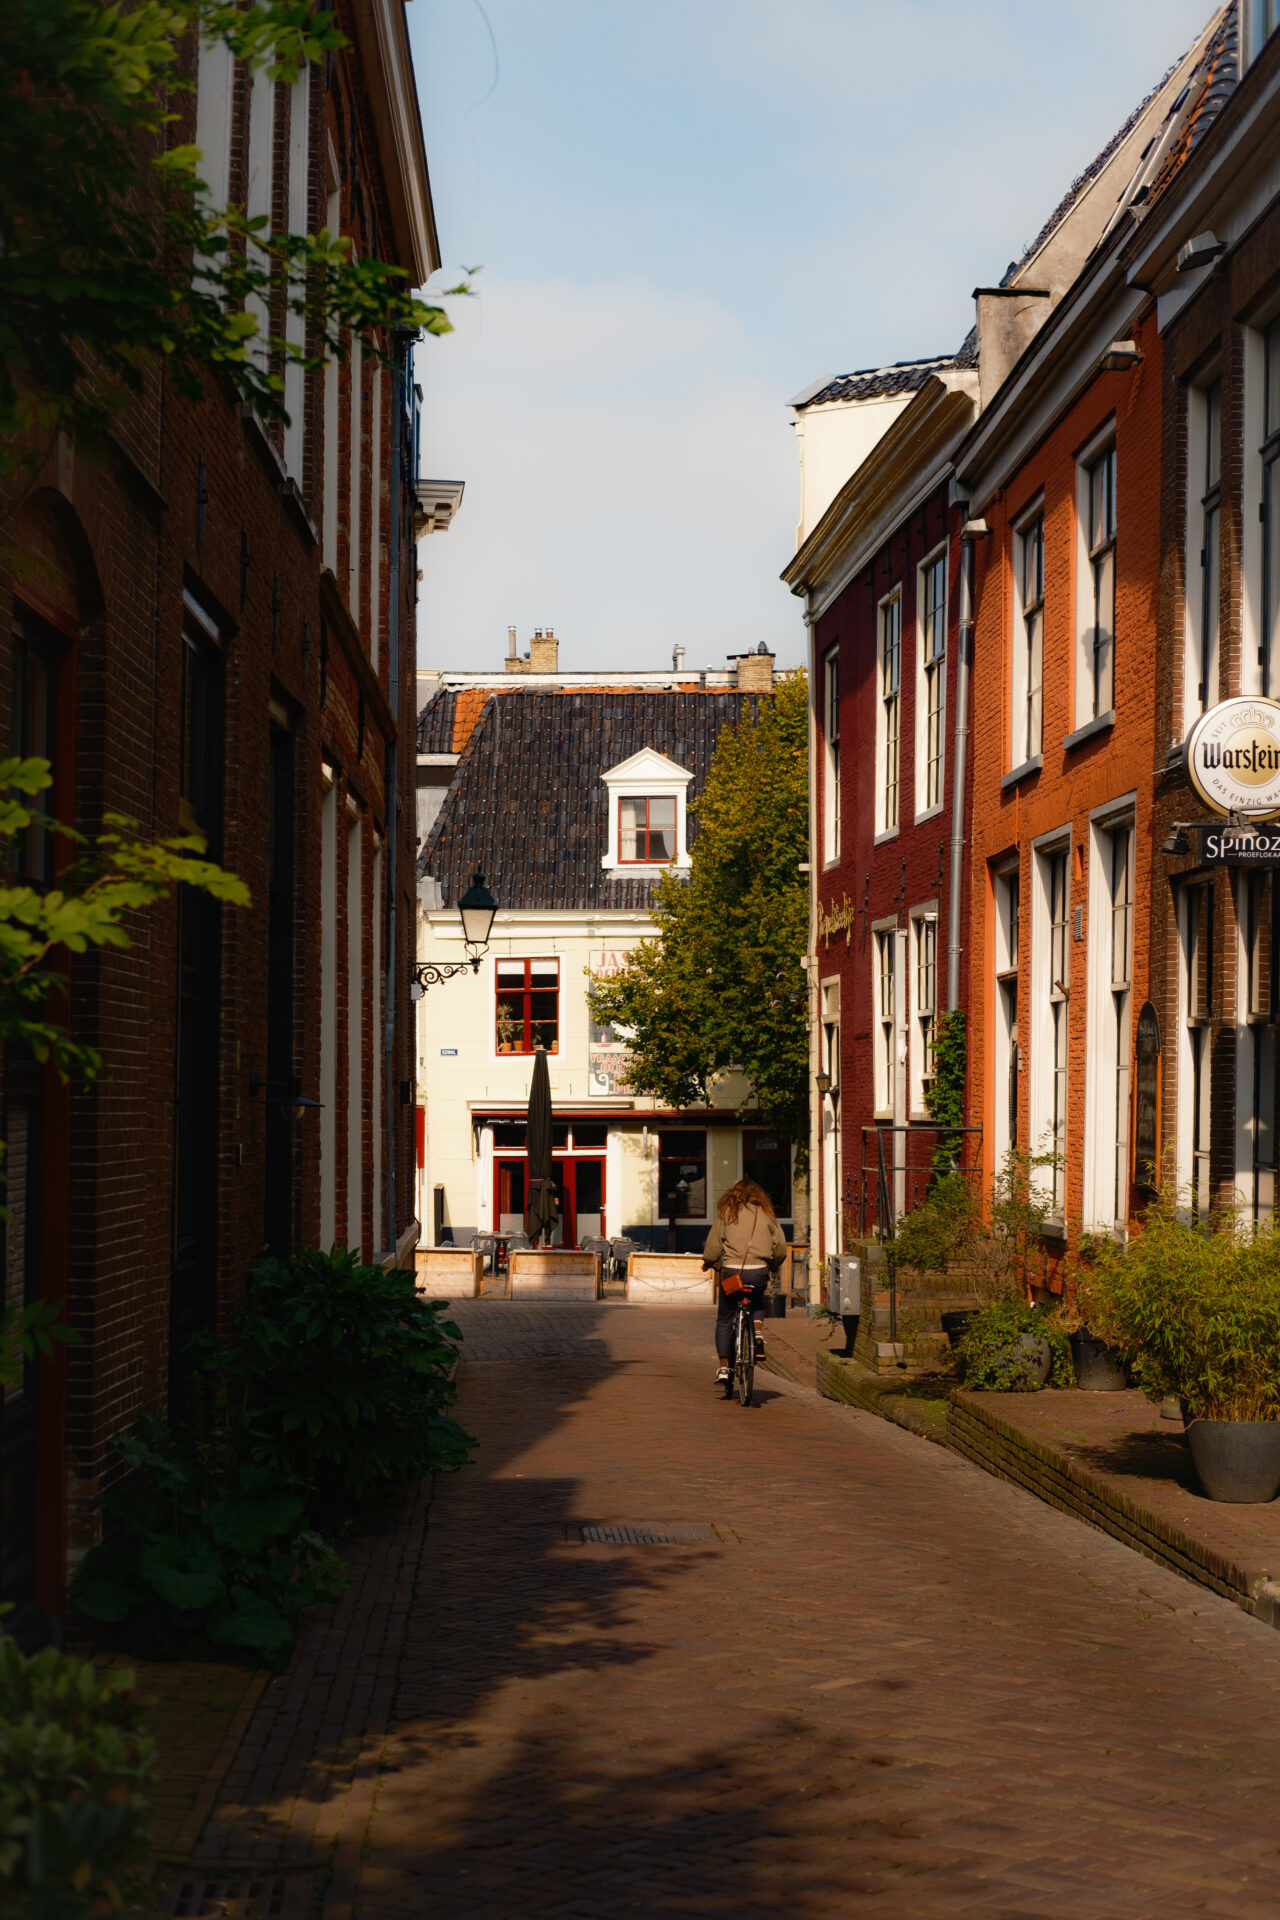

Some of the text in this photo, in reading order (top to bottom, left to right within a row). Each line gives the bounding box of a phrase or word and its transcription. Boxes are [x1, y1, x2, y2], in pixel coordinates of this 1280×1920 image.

[1212, 721, 1227, 739] SEIT
[1212, 778, 1228, 795] DAS
[1229, 792, 1262, 806] EINZIG
